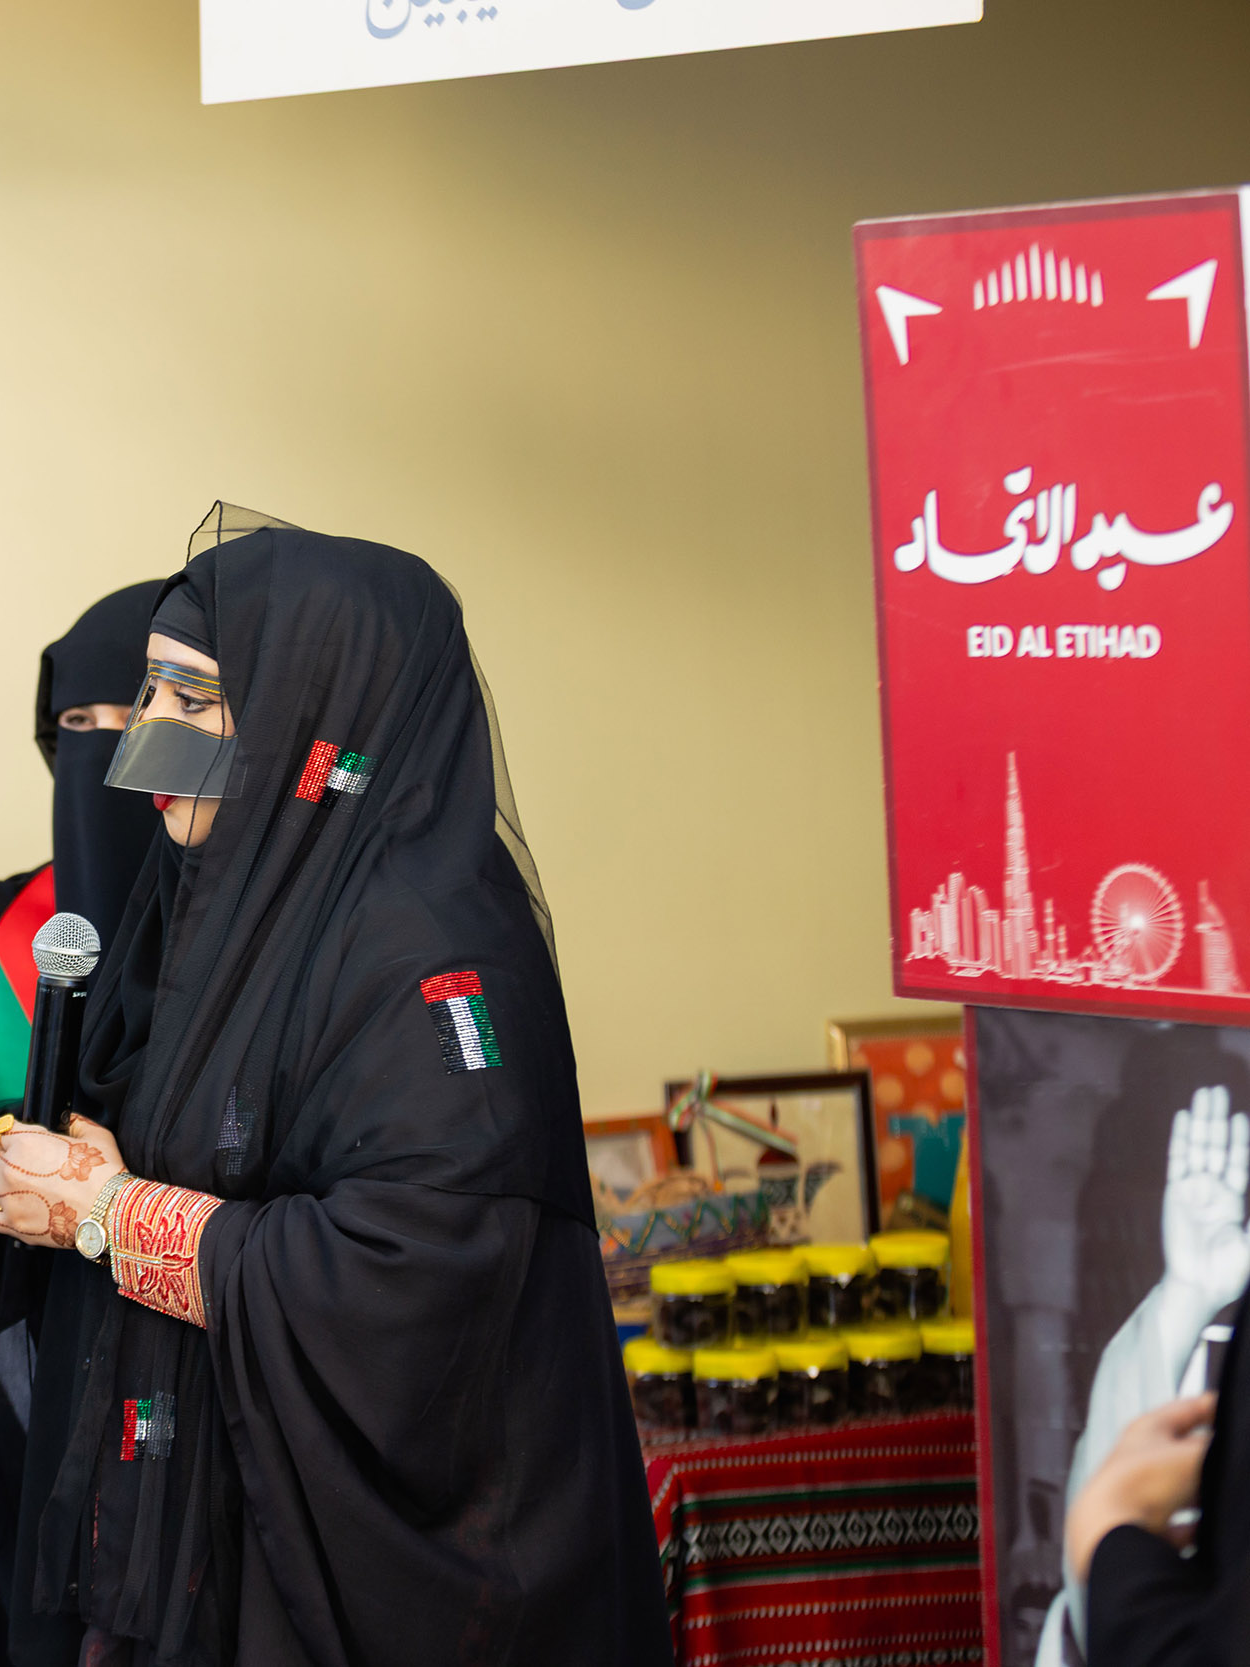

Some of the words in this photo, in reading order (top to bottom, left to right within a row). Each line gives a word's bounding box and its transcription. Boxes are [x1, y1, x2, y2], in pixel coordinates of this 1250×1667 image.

[1071, 482, 1235, 592] عيد
[967, 624, 1014, 658] EID
[1016, 624, 1054, 658] AL
[1055, 624, 1162, 659] ETIHAD
